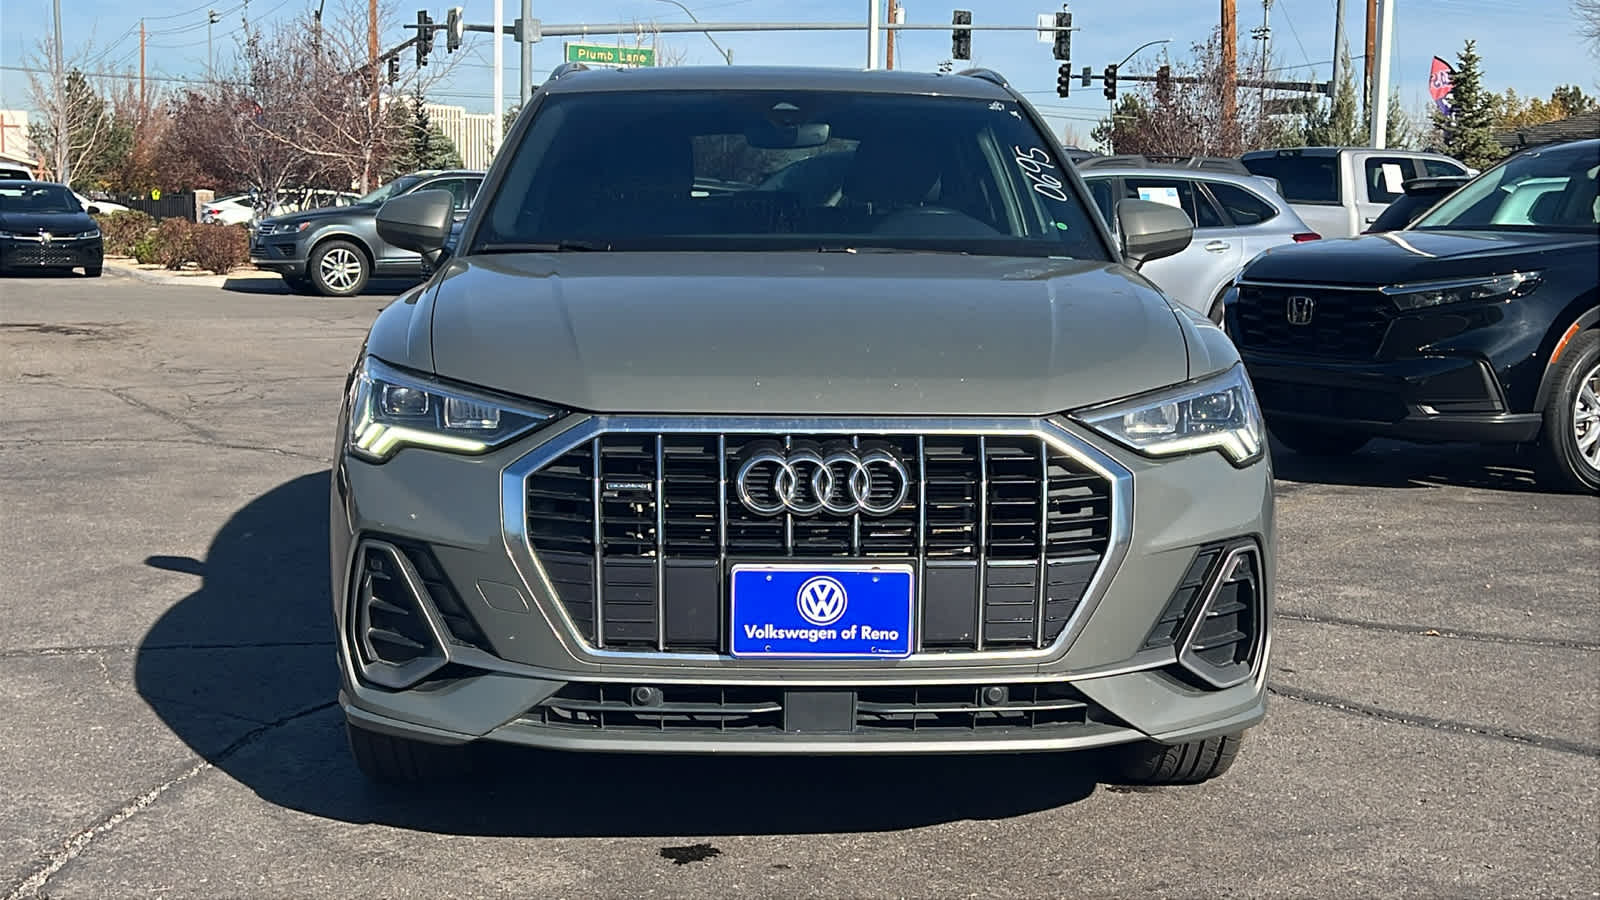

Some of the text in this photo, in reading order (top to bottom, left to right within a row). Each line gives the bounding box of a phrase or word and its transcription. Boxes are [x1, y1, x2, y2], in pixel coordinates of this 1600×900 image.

[578, 49, 647, 62] Plumb Lane
[1015, 145, 1068, 201] 0695
[744, 624, 899, 642] Volkswagen of Reno
